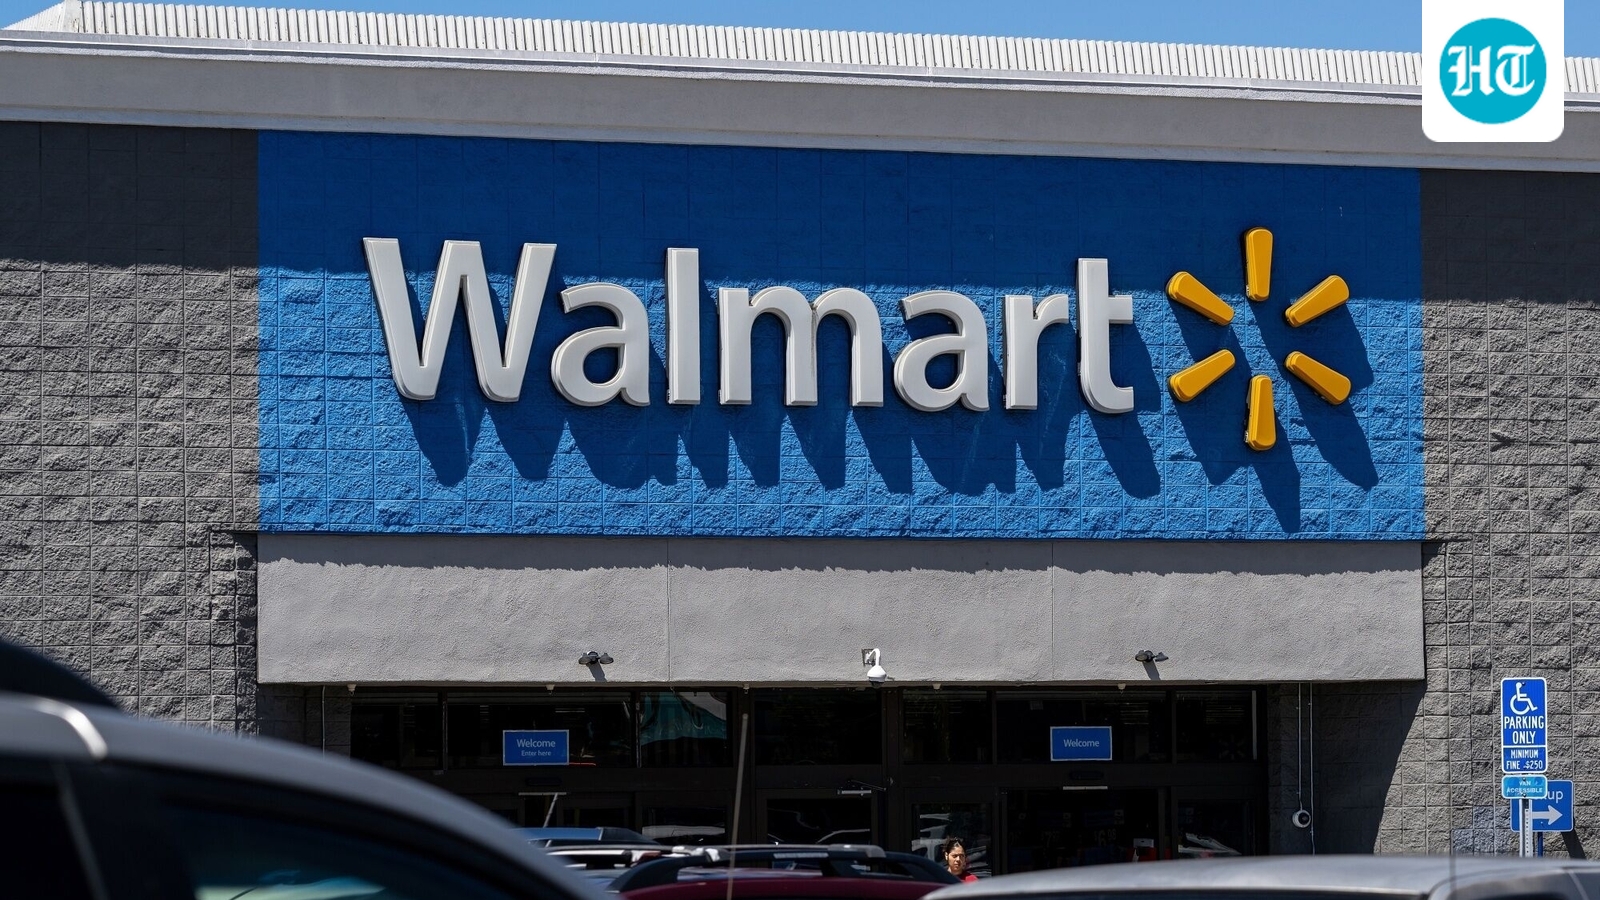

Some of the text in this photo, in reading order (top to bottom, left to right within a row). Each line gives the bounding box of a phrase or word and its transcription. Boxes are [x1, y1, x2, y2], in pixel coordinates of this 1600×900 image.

[363, 237, 1135, 415] Walmart
[1504, 715, 1545, 729] PARKING
[1512, 730, 1536, 744] ONLY
[516, 738, 556, 748] Welcome
[1063, 738, 1100, 748] Welcome
[1510, 749, 1539, 759] MINIMUM
[1506, 760, 1544, 770] FINE $250
